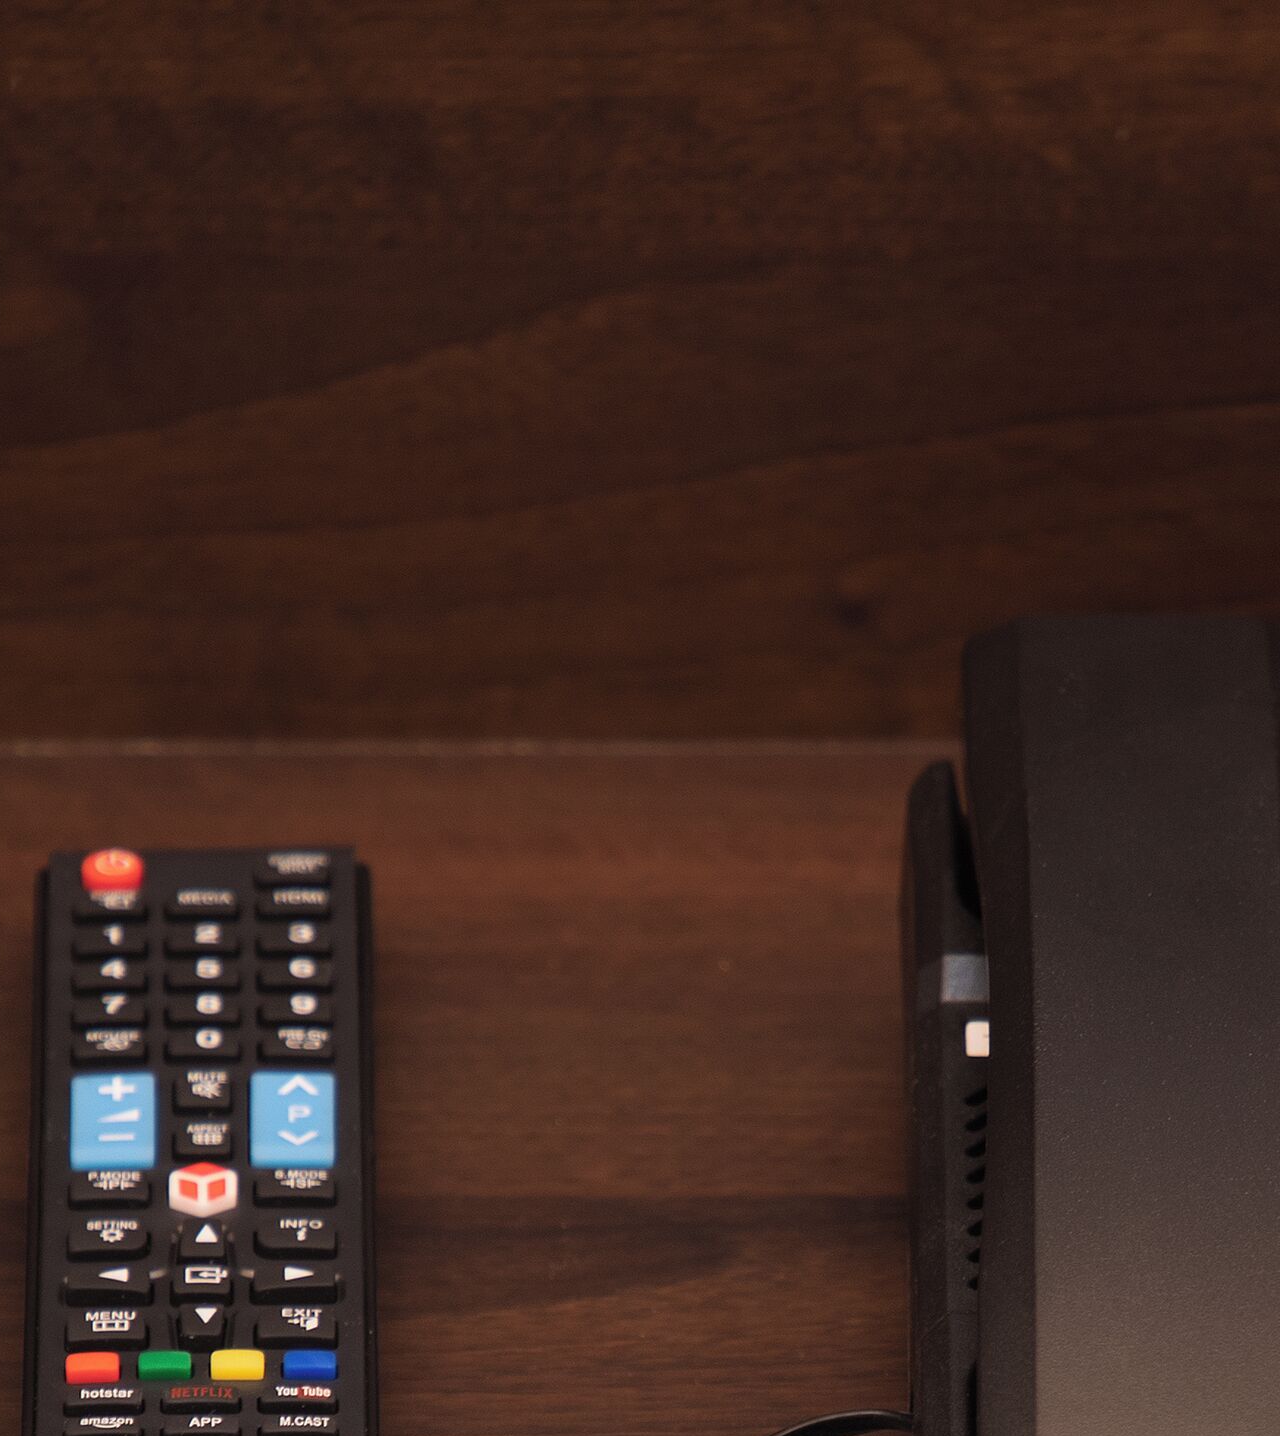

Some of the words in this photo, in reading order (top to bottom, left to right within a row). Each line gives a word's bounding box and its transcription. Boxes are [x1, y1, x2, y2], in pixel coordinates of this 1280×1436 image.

[103, 924, 124, 945] 1
[194, 923, 221, 944] 2
[99, 958, 127, 980] 4
[101, 994, 127, 1015] 7
[195, 1028, 223, 1049] 0
[187, 1071, 227, 1084] MUTE
[287, 1105, 312, 1123] P
[87, 1171, 142, 1182] P.MODE
[86, 1220, 138, 1231] SETTING
[279, 1219, 324, 1230] INFO
[85, 1311, 137, 1322] MENU
[281, 1308, 323, 1319] EXIT
[80, 1388, 134, 1400] hotstar
[171, 1387, 234, 1400] NETFLIX
[80, 1416, 135, 1428] amazon
[188, 1417, 223, 1428] APP
[279, 1416, 331, 1428] M.CAST
